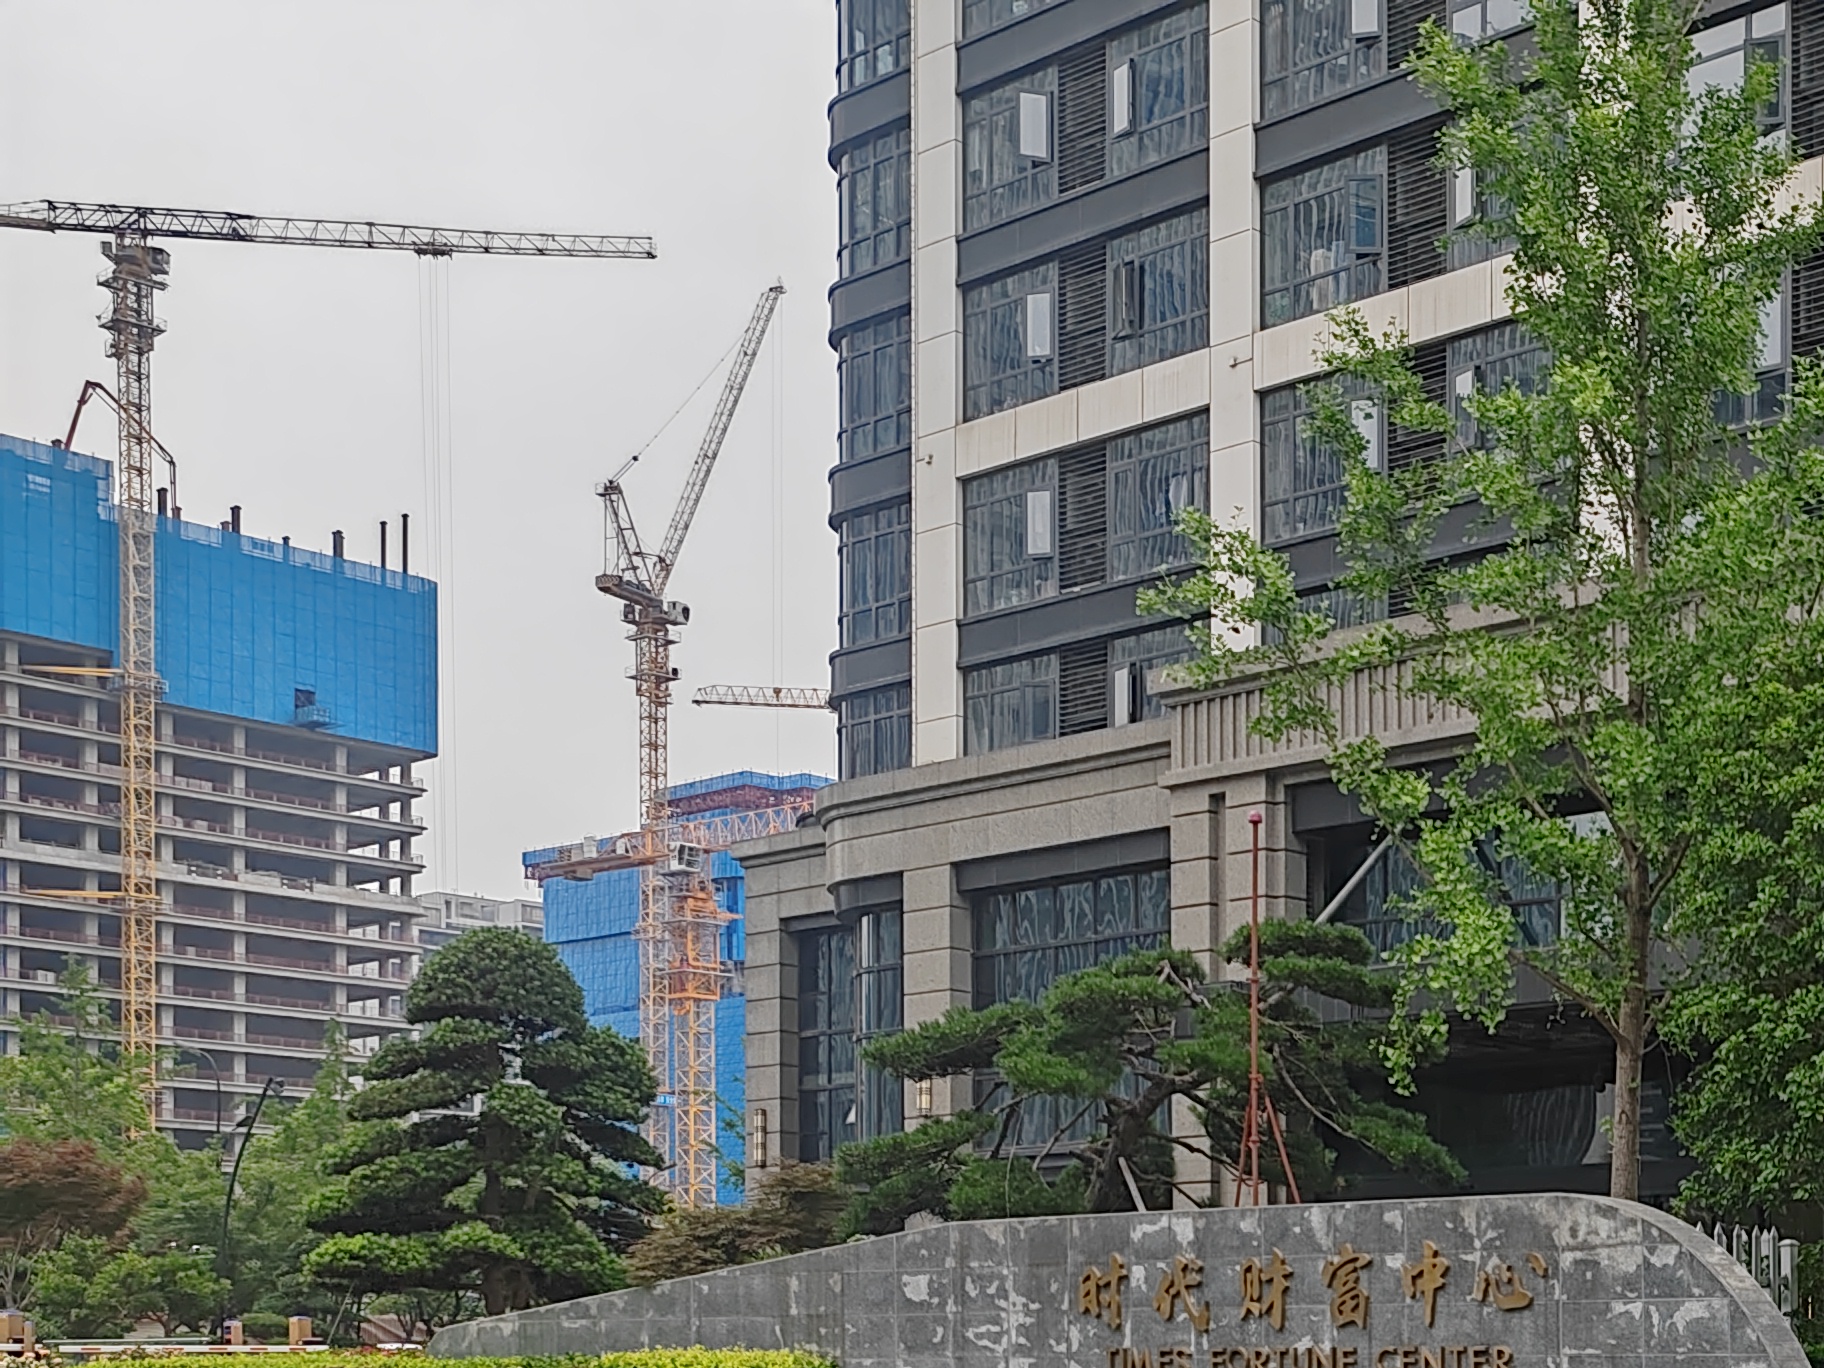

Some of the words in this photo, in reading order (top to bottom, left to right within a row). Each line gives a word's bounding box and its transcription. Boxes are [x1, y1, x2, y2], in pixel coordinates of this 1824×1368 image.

[1078, 1240, 1548, 1333] 时代财富中心
